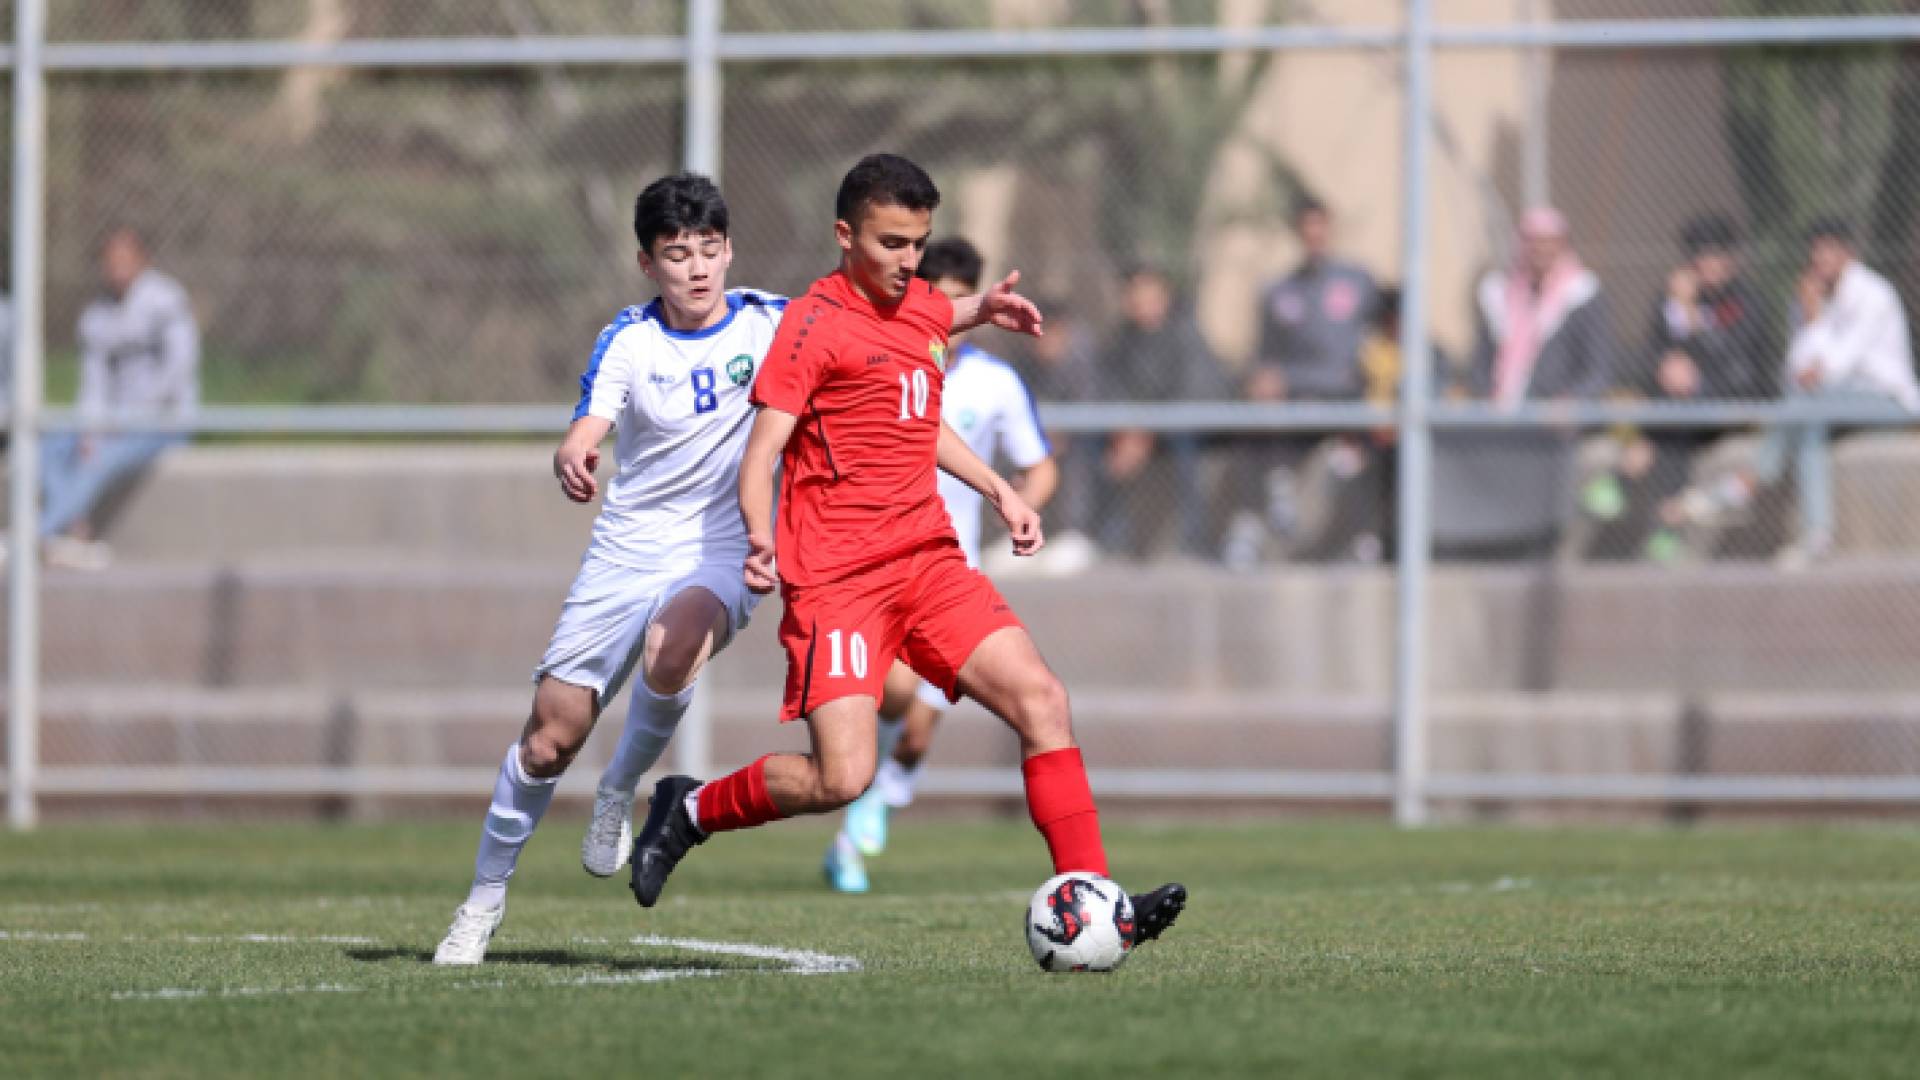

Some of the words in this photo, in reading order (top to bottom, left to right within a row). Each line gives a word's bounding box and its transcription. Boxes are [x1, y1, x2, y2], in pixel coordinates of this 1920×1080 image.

[691, 367, 717, 413] 8
[899, 369, 928, 419] 10
[826, 629, 868, 678] 10
